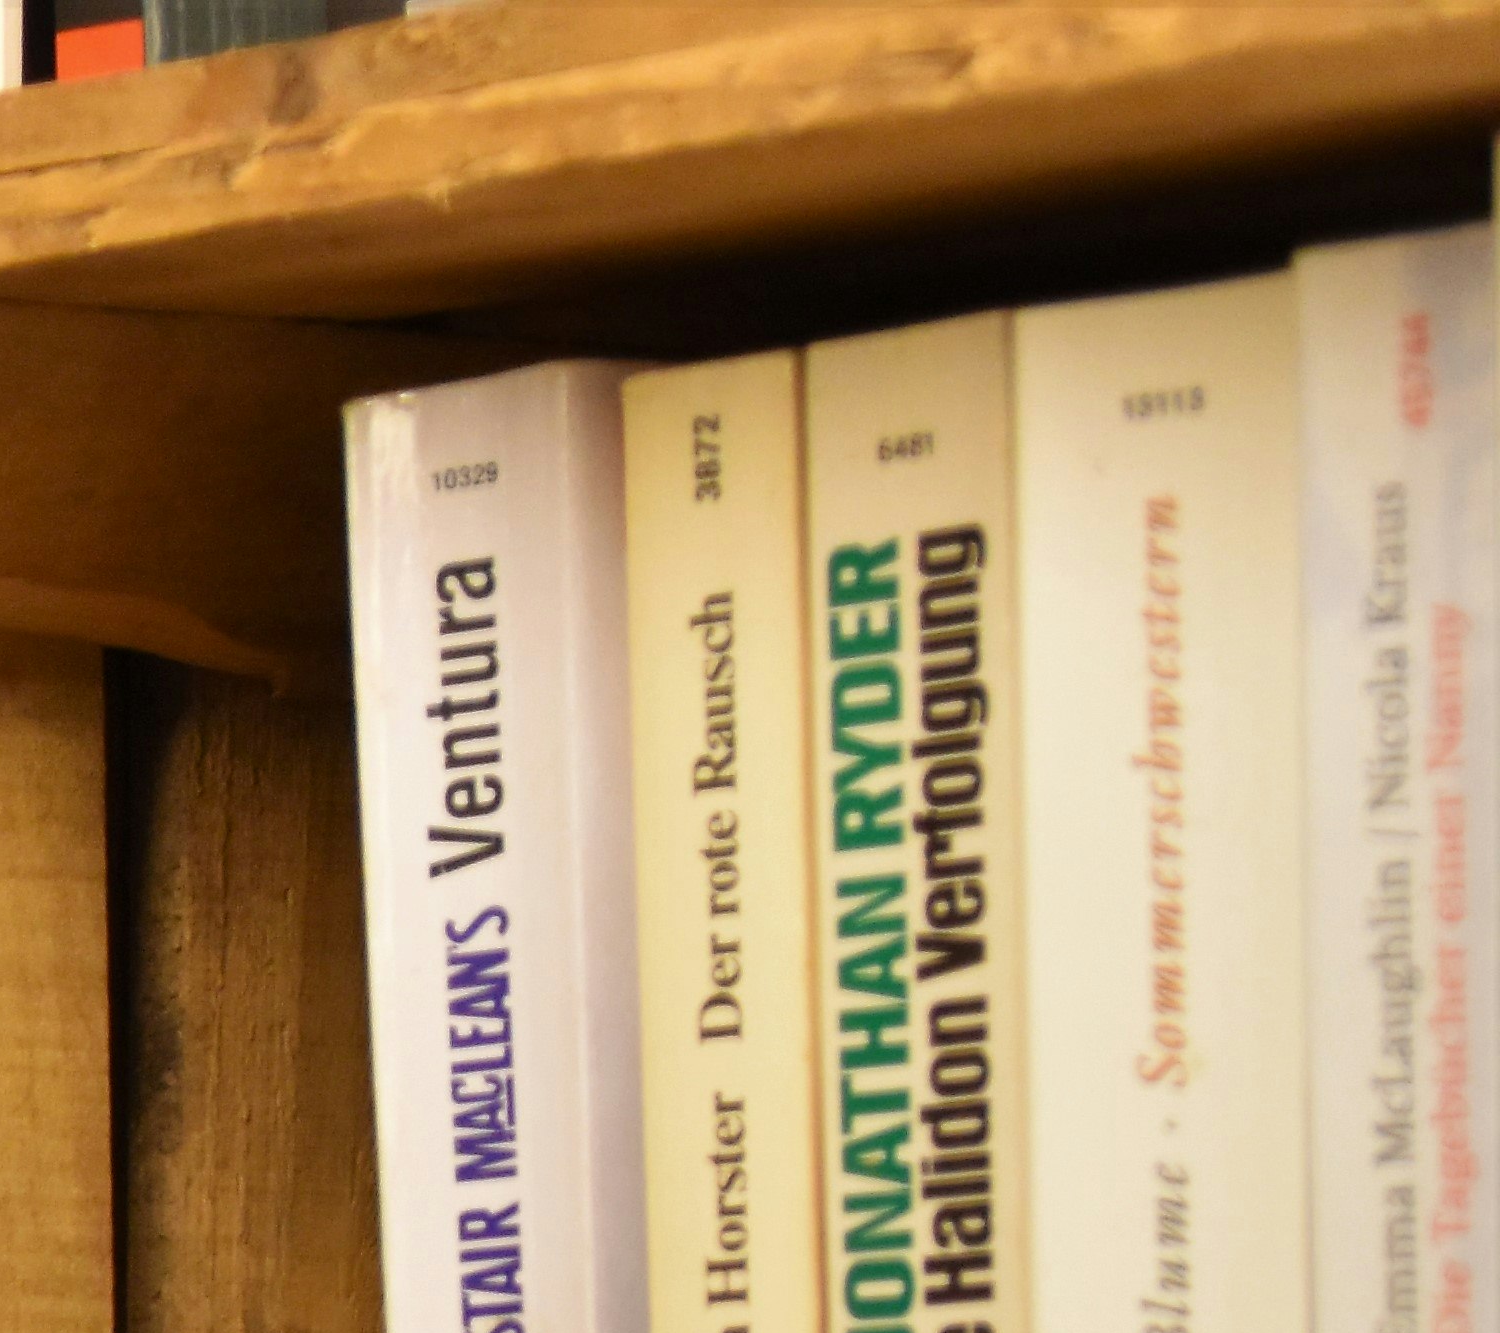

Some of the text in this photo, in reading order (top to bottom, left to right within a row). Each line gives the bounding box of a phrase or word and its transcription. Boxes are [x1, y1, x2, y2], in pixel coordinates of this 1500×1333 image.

[430, 461, 500, 495] 10329
[427, 555, 508, 880] Ventura
[688, 591, 744, 1047] Der rote Rausch
[827, 535, 905, 854] RYDER
[912, 520, 988, 981] Verfolgung
[703, 1093, 751, 1294] Horster
[920, 994, 993, 1306] Halidon
